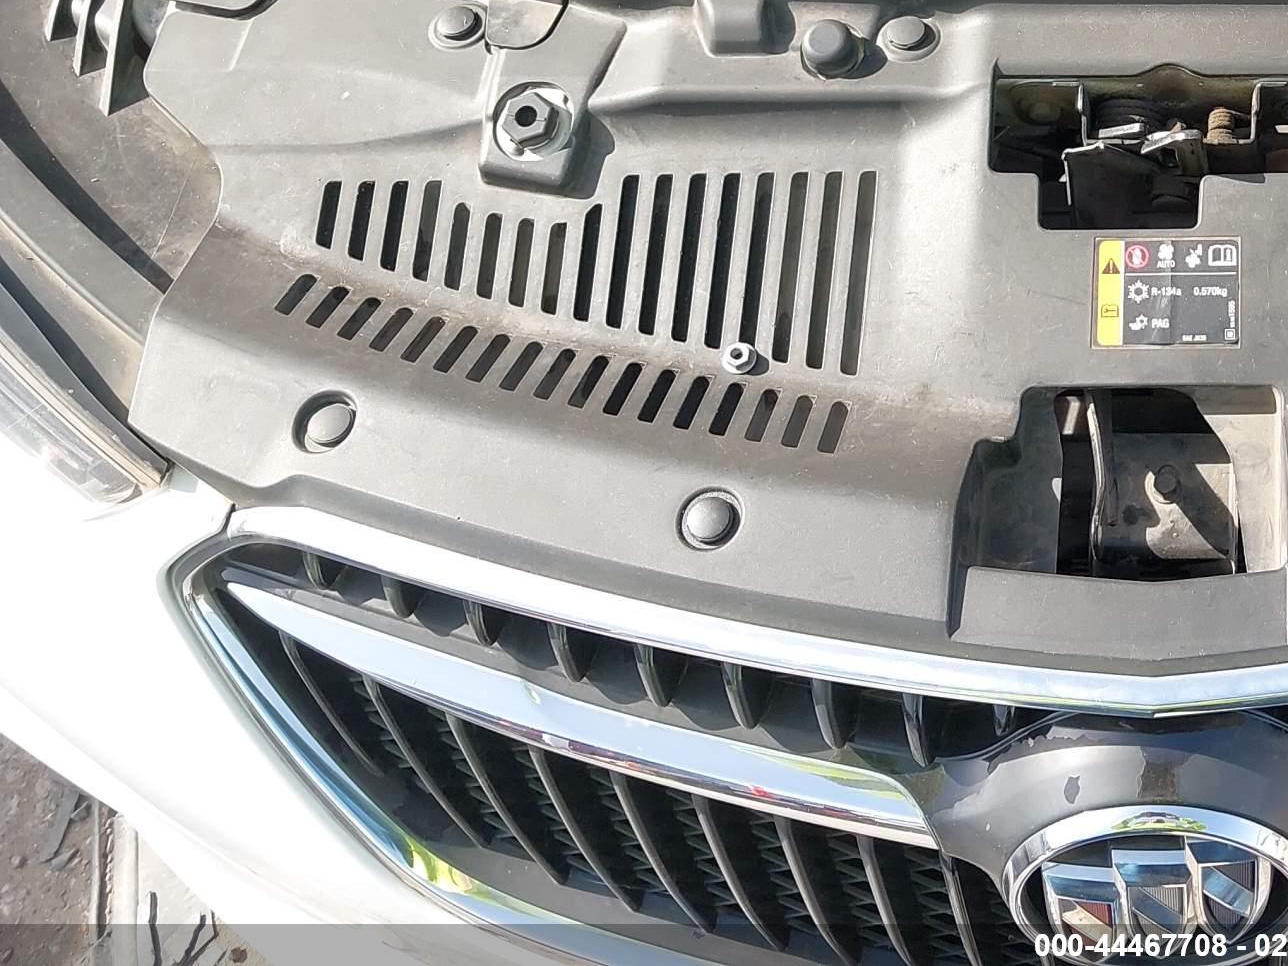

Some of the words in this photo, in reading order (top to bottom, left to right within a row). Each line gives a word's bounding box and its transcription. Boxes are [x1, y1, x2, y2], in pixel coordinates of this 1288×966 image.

[1156, 260, 1176, 268] AUTO
[1151, 286, 1182, 296] R-134a
[1193, 286, 1228, 298] 0.570kg
[1151, 318, 1170, 328] PAG
